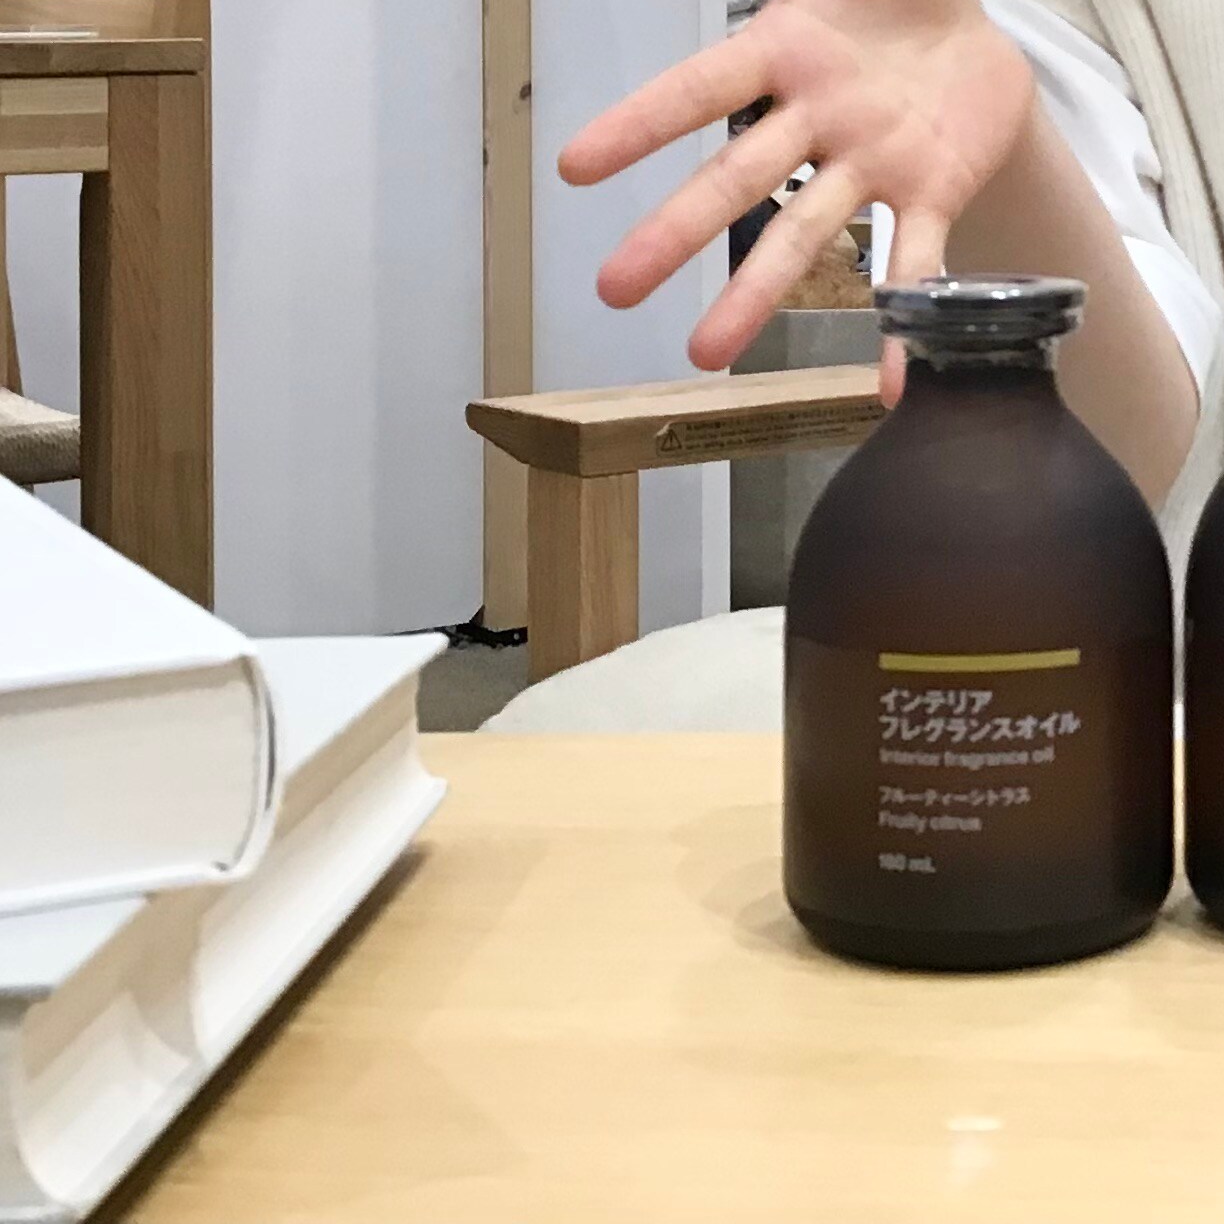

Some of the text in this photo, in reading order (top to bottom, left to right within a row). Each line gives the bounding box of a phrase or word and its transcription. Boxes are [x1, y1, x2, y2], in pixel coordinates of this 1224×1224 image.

[879, 687, 993, 715] インテリア
[879, 710, 1081, 743] フレグランスオイル
